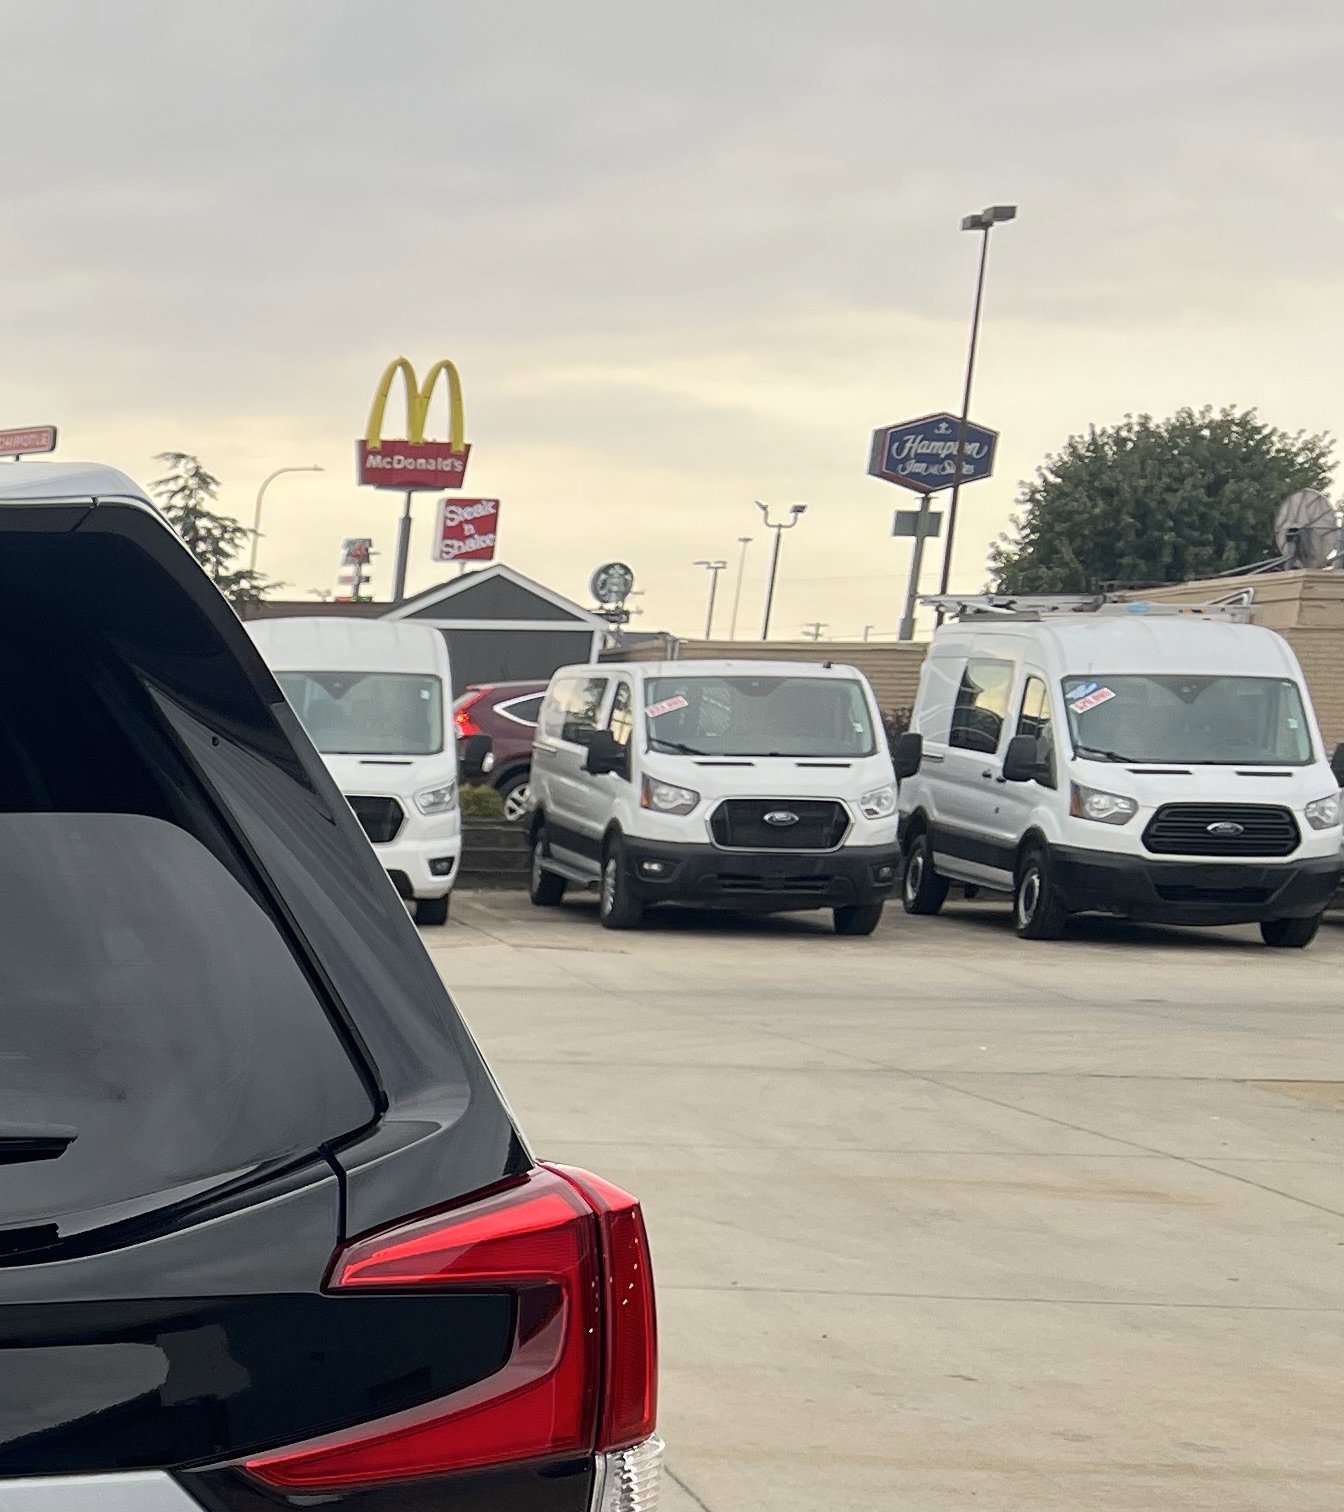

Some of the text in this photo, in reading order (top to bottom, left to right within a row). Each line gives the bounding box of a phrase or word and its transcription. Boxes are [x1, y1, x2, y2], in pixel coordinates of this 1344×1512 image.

[365, 454, 464, 473] McDonald's
[444, 500, 496, 527] Steak
[441, 533, 496, 559] Shake
